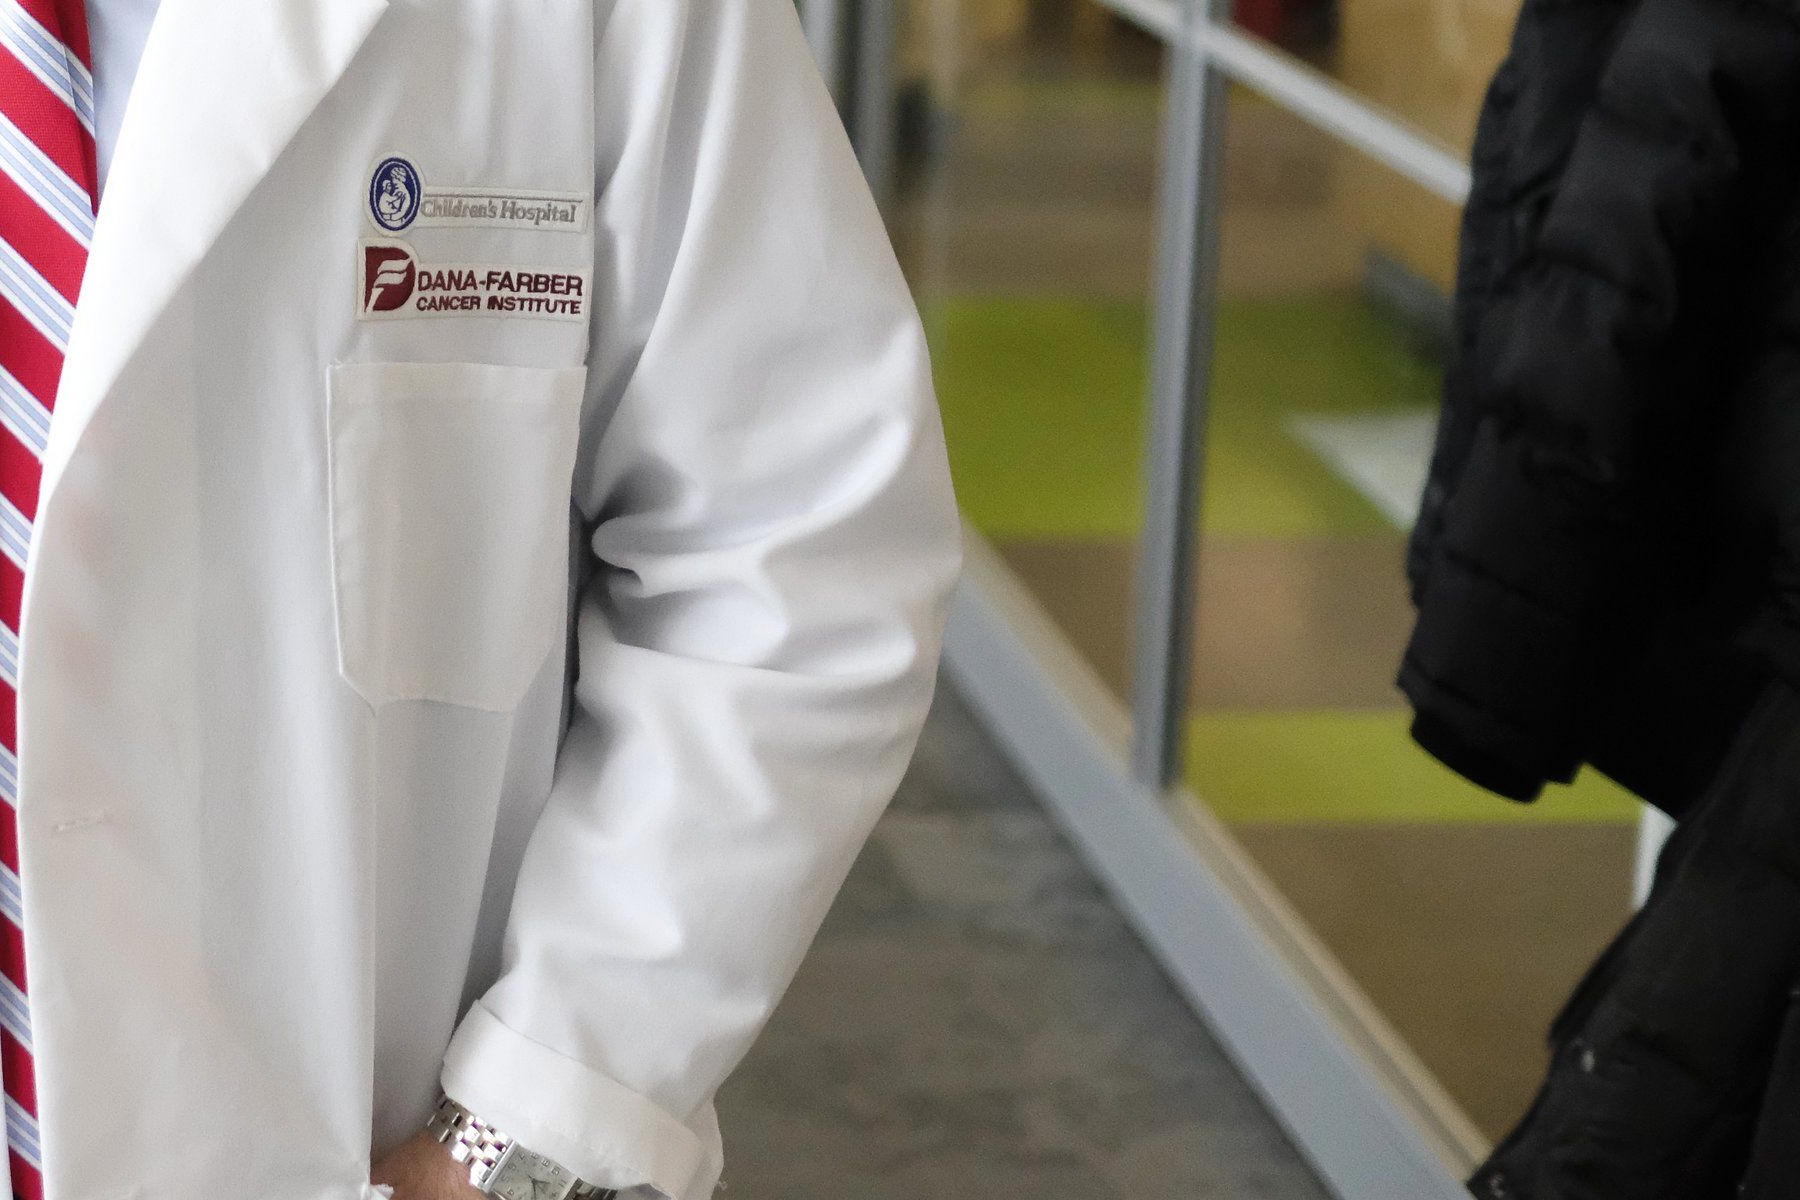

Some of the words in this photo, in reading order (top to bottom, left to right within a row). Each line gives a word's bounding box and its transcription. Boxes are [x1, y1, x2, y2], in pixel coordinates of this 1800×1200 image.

[420, 199, 498, 219] Children's
[499, 200, 576, 225] Hospital
[417, 269, 583, 297] DANA-FARBER
[416, 295, 481, 311] CANCER
[487, 296, 581, 315] INSTITUTE
